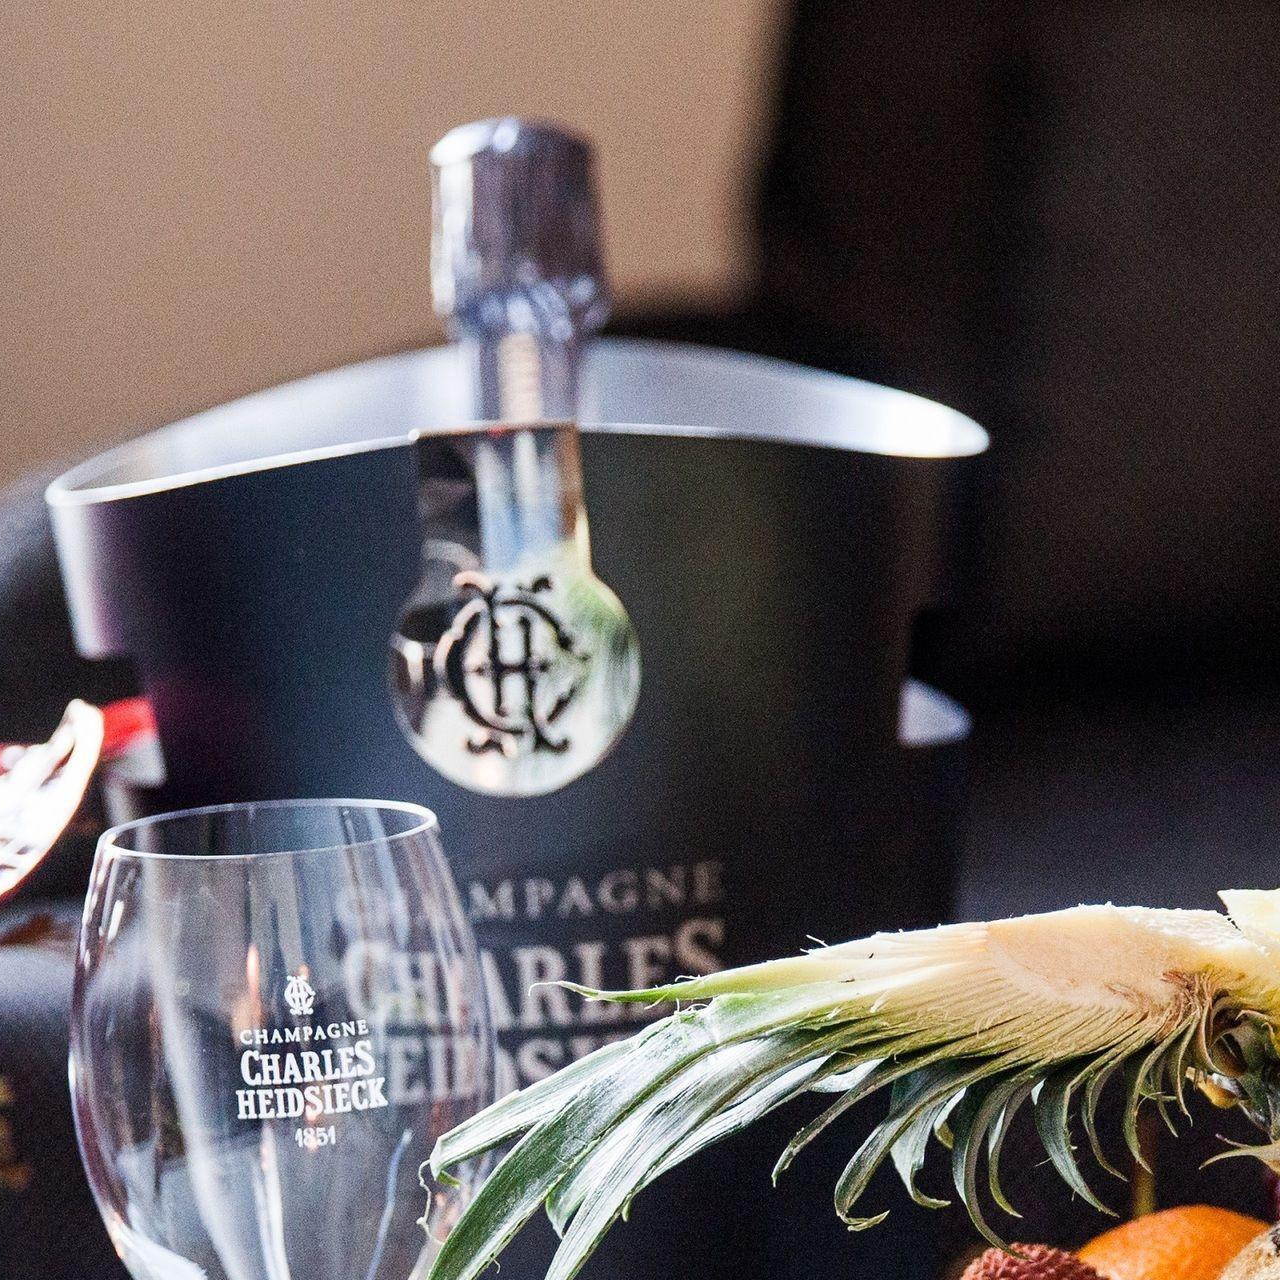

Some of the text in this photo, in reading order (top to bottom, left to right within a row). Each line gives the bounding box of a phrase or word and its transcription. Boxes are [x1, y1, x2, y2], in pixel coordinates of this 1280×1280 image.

[239, 1019, 369, 1045] CHAMPAGNE
[240, 1039, 376, 1087] CHARLES
[235, 1077, 388, 1120] HEIDSIECK
[294, 1125, 336, 1148] 1851
